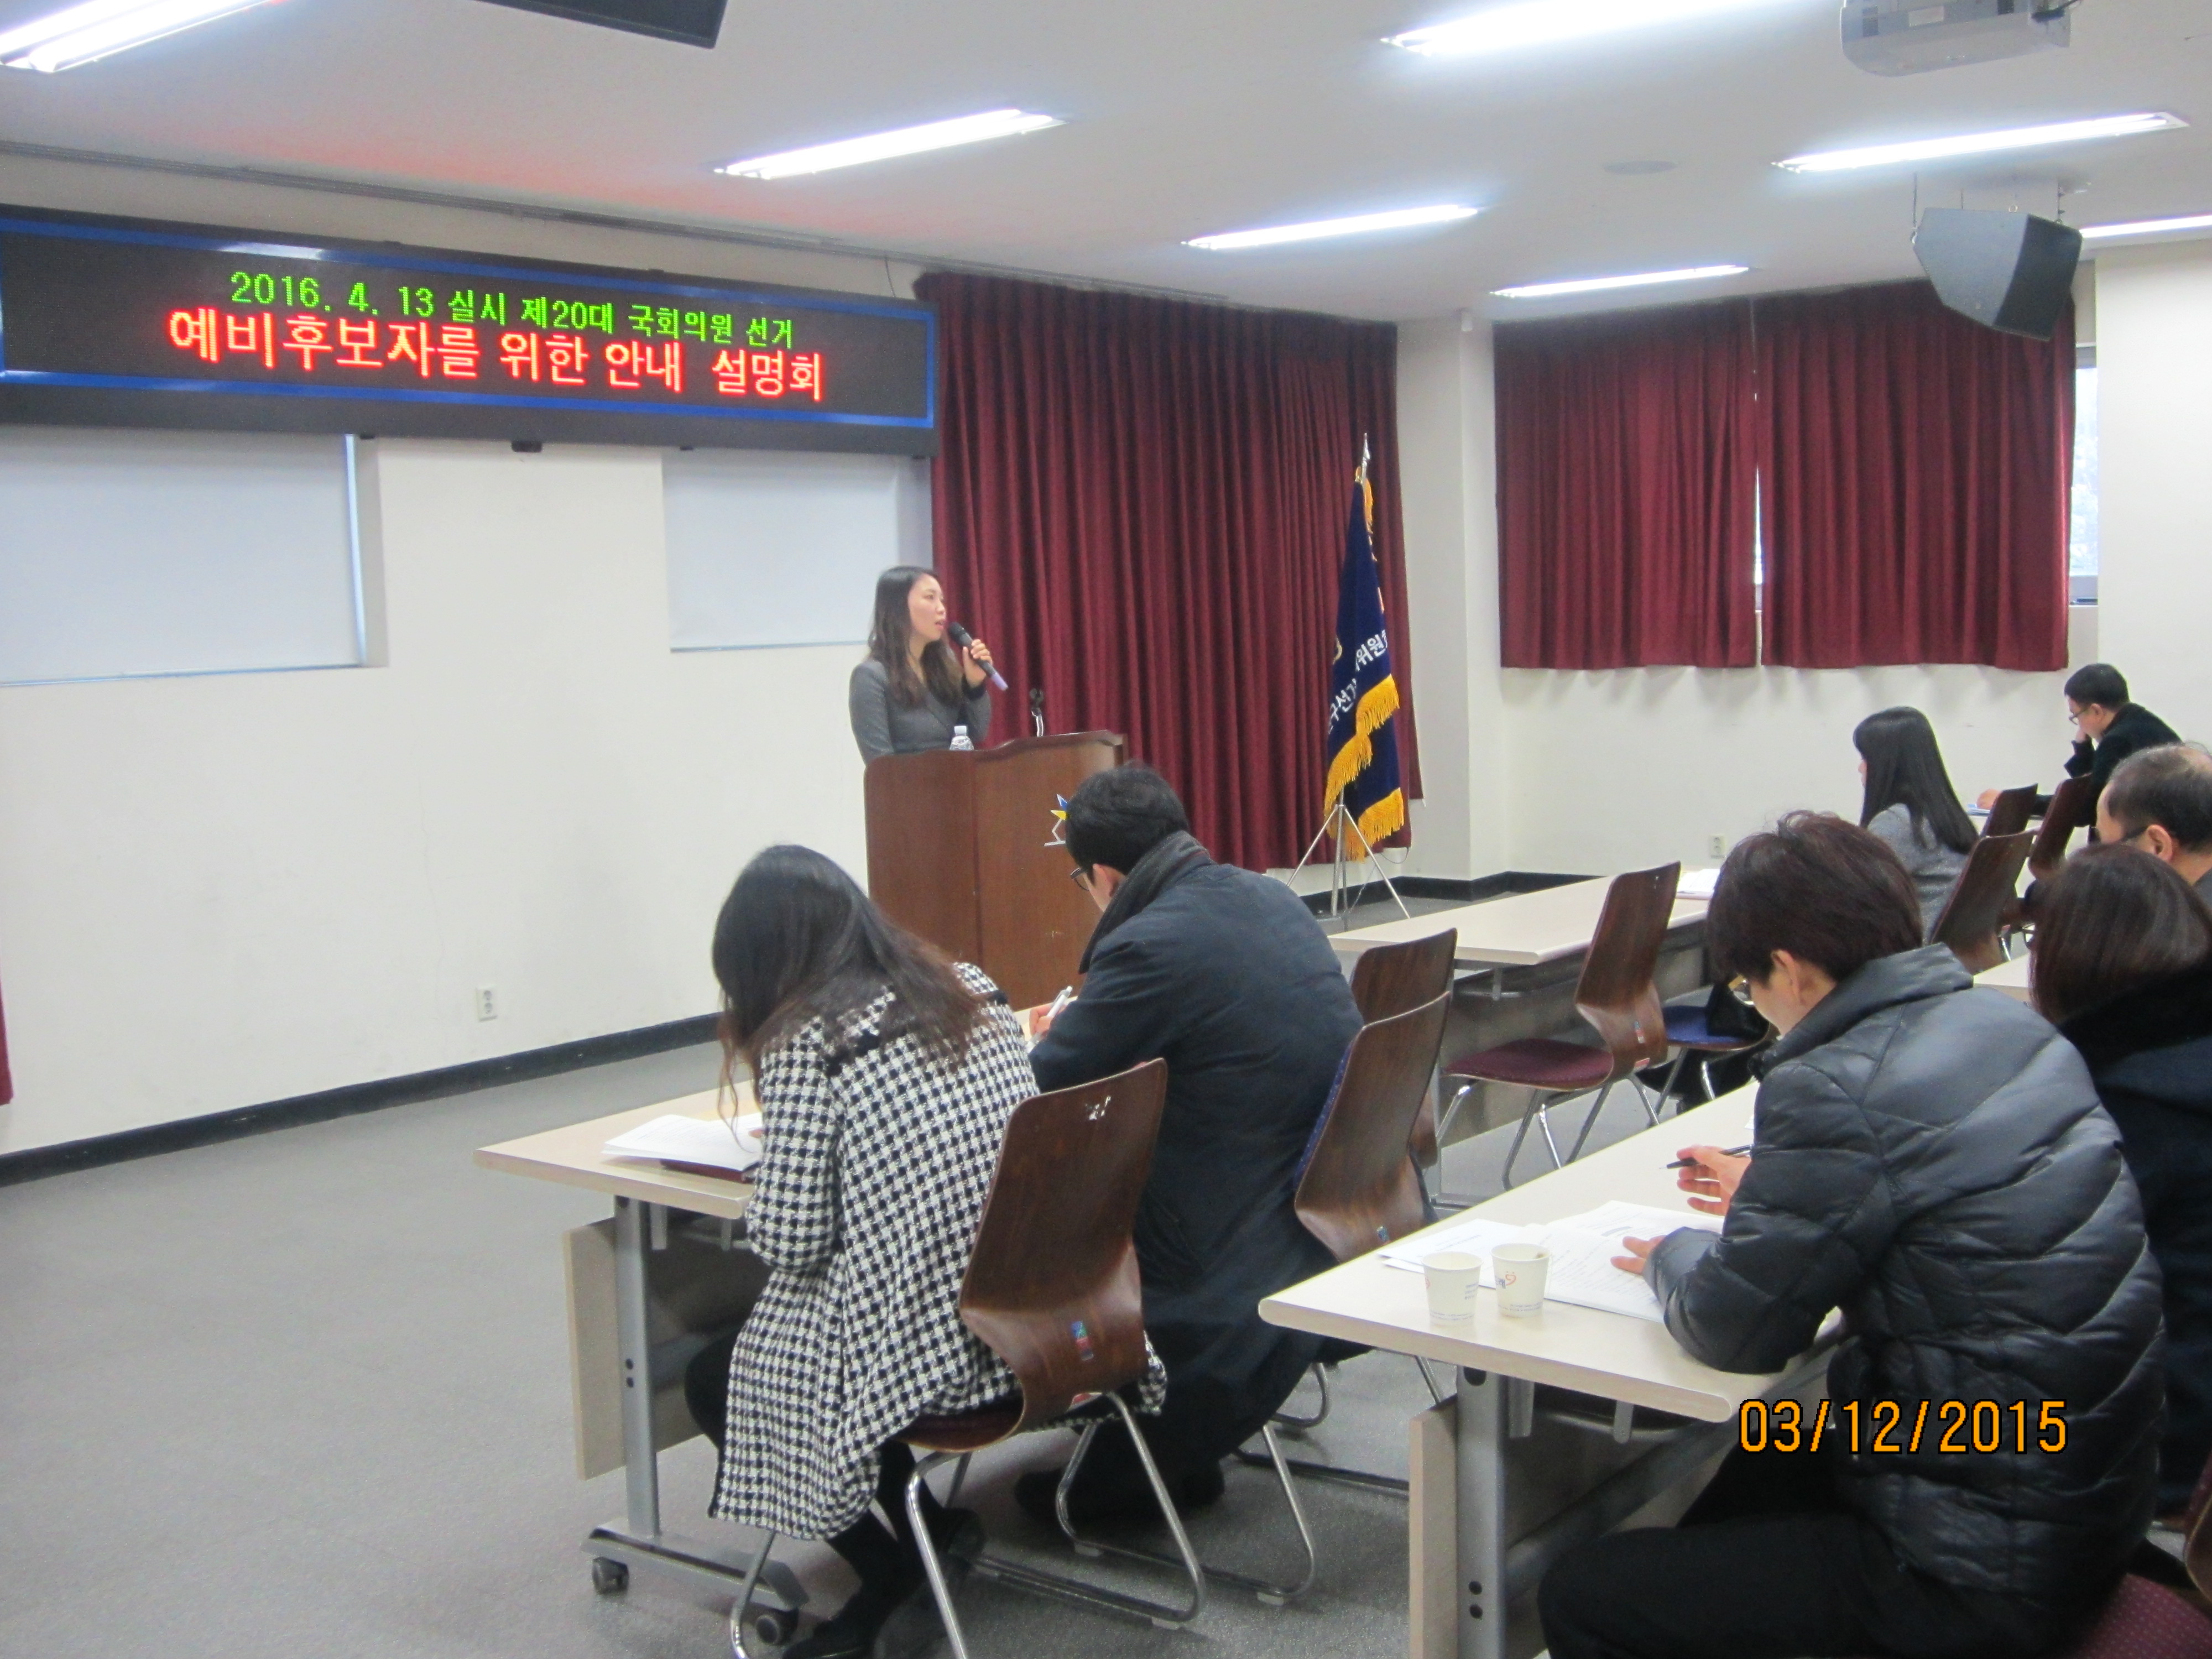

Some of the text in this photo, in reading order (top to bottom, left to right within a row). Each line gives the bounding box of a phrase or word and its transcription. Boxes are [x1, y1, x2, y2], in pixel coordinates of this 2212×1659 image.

[231, 271, 793, 348] 2016. 4. 13 실시 제20대 국회의원 선거
[168, 307, 822, 401] 예비후보자를 위한 안내 설명회
